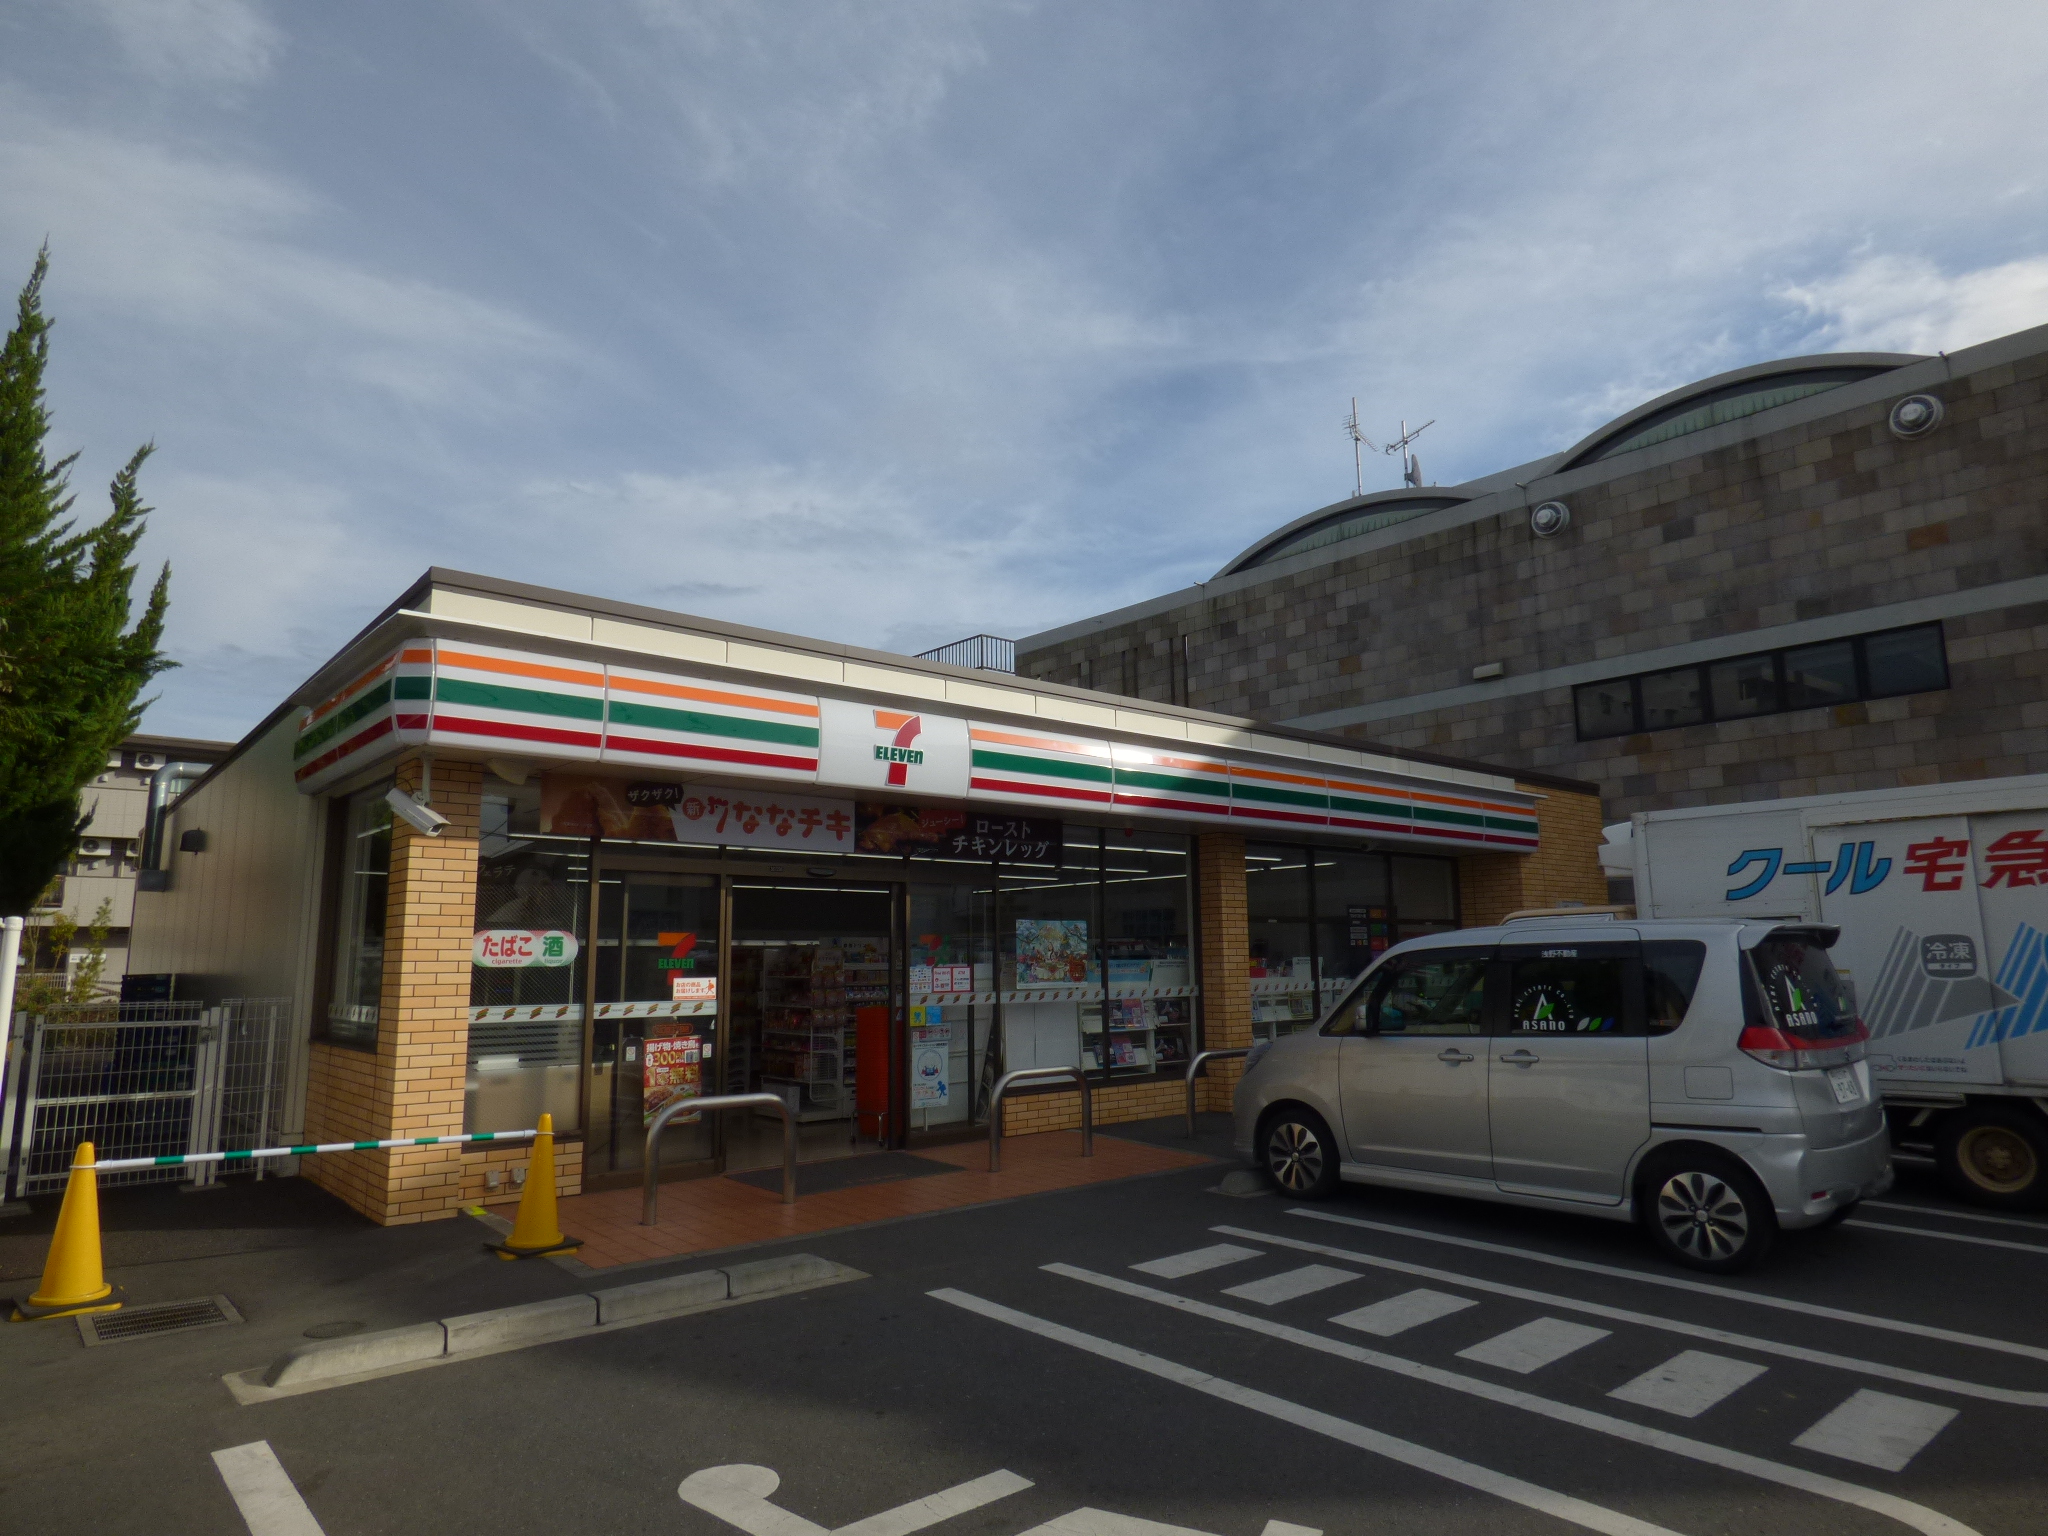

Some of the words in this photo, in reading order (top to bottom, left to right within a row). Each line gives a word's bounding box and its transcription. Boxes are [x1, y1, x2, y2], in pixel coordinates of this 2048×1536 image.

[976, 819, 1031, 839] ロースト
[952, 835, 1050, 859] チキンレッグ
[482, 935, 533, 958] たばこ
[542, 936, 564, 957] 酒
[1925, 941, 1972, 960] 冷凍
[491, 958, 523, 966] cigarette
